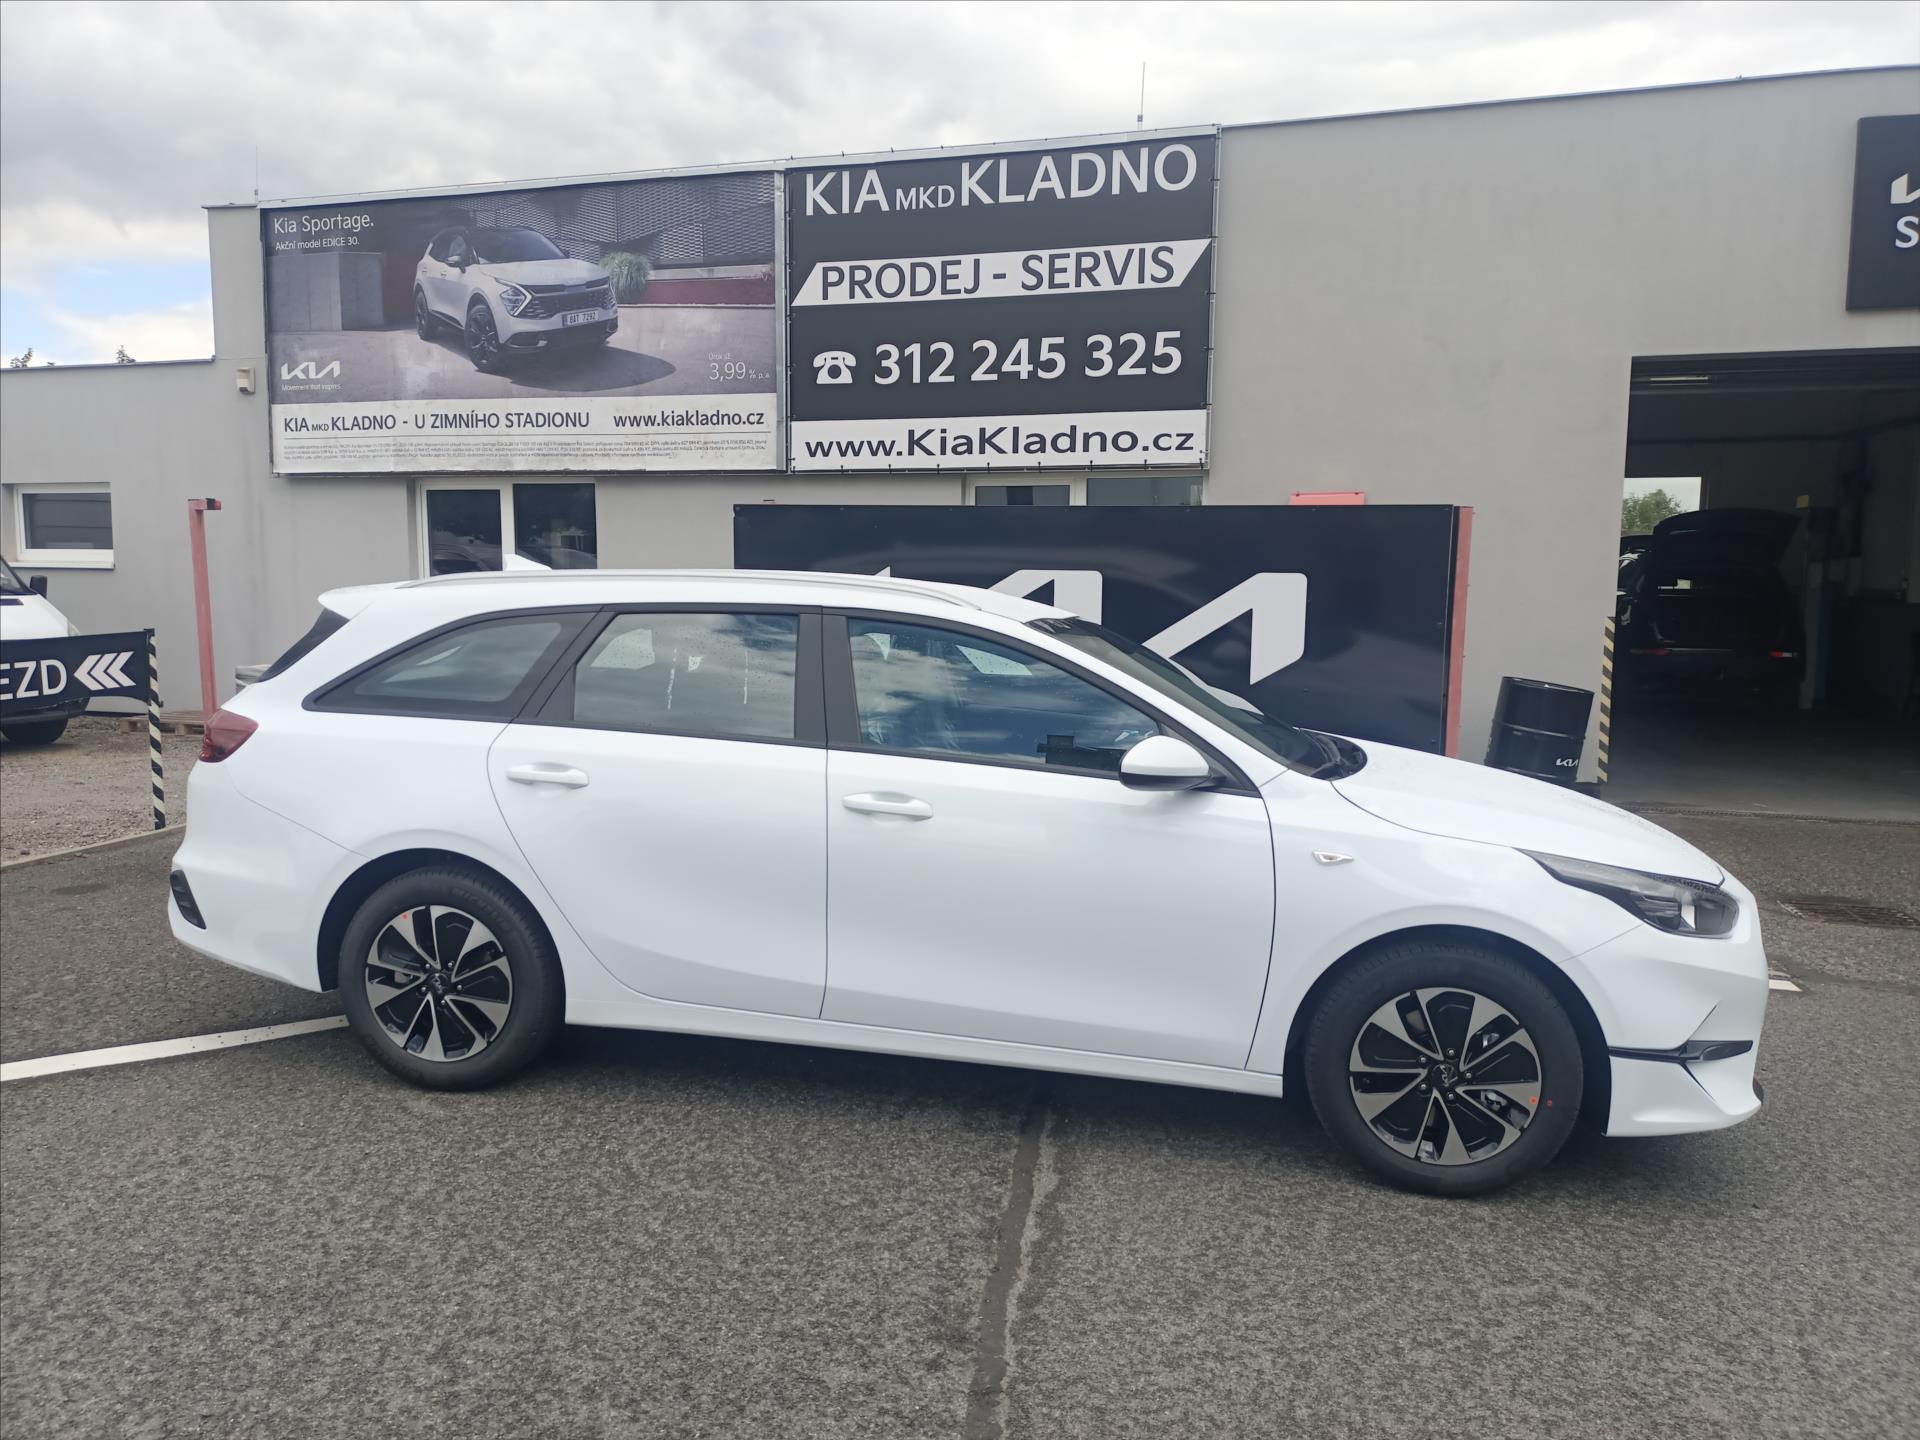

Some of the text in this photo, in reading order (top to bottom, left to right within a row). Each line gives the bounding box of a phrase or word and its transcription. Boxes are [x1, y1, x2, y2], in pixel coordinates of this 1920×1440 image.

[805, 143, 1198, 216] KIA MKD KLADNO
[274, 213, 375, 236] Kia Sportage.
[275, 240, 296, 251] Akční
[297, 238, 321, 250] model
[322, 236, 346, 248] EDICE
[821, 258, 981, 301] PRODEJ
[1020, 245, 1175, 291] SERVIS
[873, 330, 1183, 385] 312 245 325
[281, 360, 340, 380] KIA
[708, 361, 746, 382] 3,99
[284, 416, 310, 433] KIA
[311, 422, 330, 432] MKD
[331, 414, 397, 432] KLADNO
[414, 414, 426, 429] U
[430, 410, 500, 429] ZIMNÍHO
[504, 411, 590, 429] STADIONU
[613, 409, 765, 428] www.kiakladno.cz
[804, 424, 1195, 458] www.KiaKladno.cz
